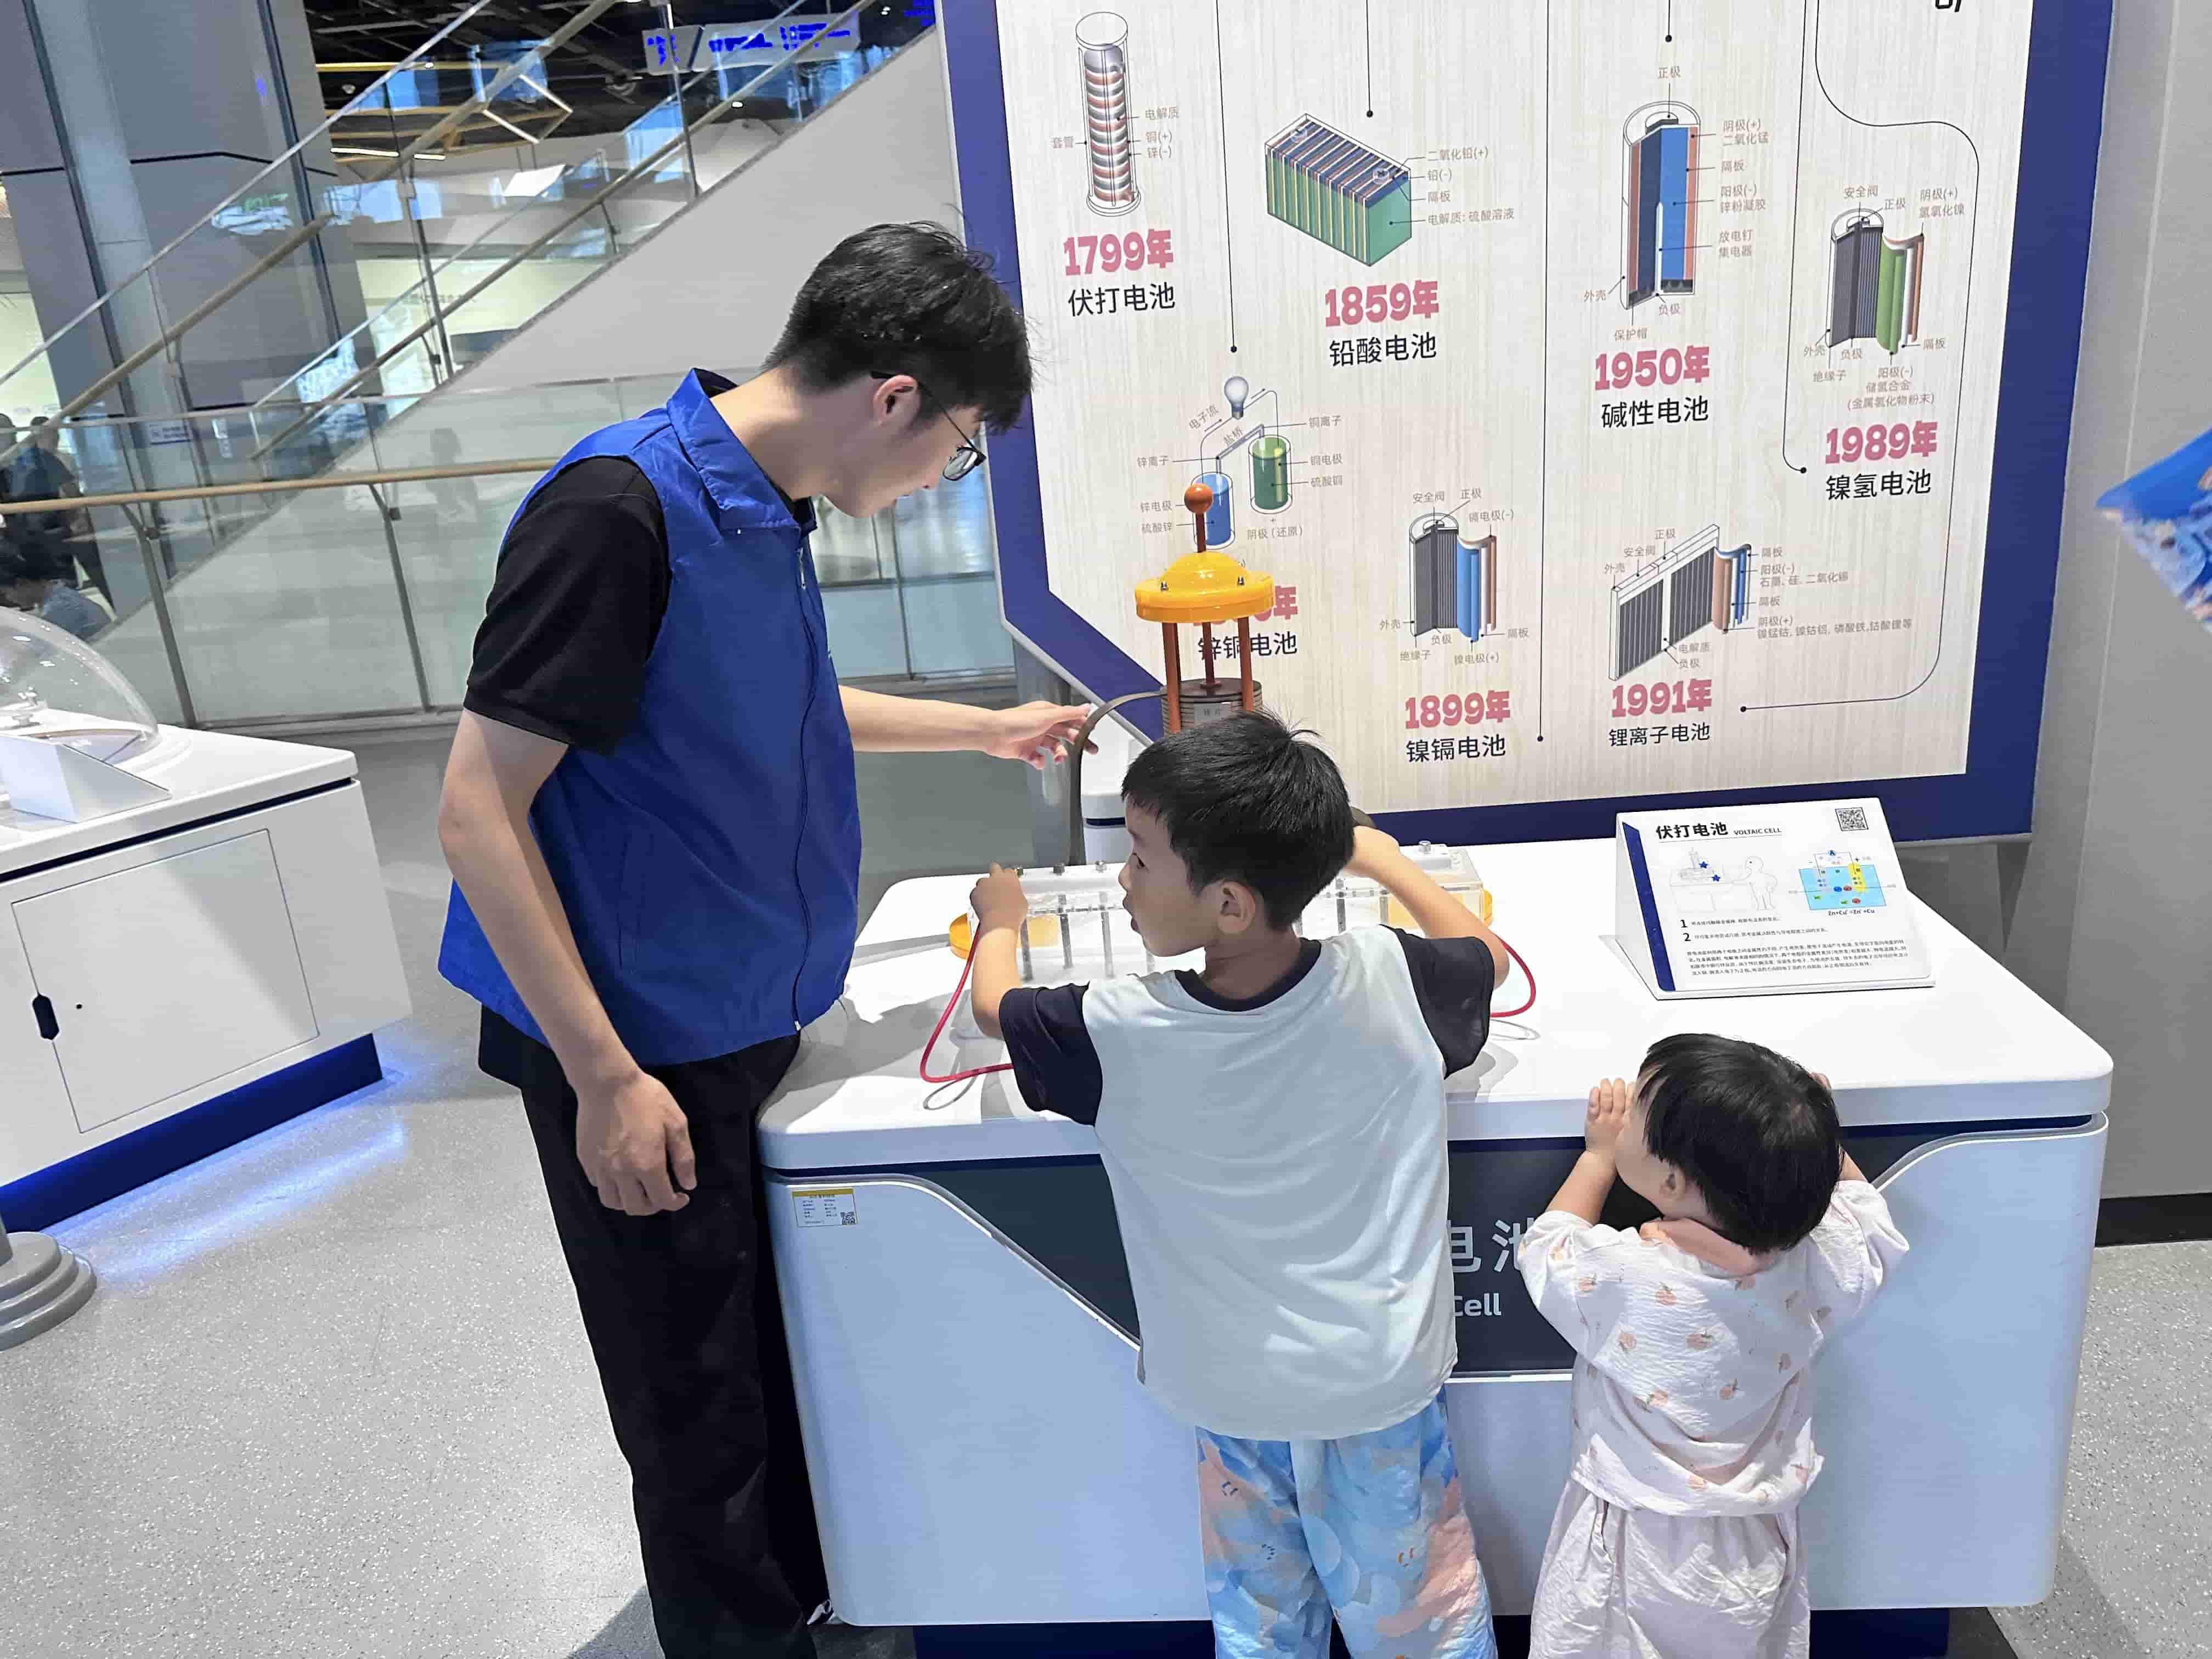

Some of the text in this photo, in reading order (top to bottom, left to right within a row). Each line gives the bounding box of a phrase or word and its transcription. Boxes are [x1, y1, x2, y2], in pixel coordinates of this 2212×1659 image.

[1657, 66, 1681, 79] 正极
[1144, 105, 1181, 121] 电解质
[1723, 119, 1760, 133] 阴极(+)
[1427, 146, 1488, 162] 二氧化铅(+)
[1844, 185, 1878, 199] 安全阀
[1920, 187, 1958, 202] 阴极(+)
[1884, 198, 1906, 211] 正极
[1063, 229, 1173, 275] 1799年
[1068, 281, 1176, 317] 伏打电池
[1325, 279, 1439, 327] 1859年
[1584, 289, 1606, 302] 外壳
[1329, 331, 1437, 367] 铅酸电池
[1595, 346, 1709, 391] 1950年
[1601, 395, 1708, 428] 碱性电池
[1825, 420, 1938, 465] 1989年
[1826, 469, 1931, 500] 镍氢电池
[1413, 491, 1445, 504] 安全阀
[1461, 487, 1482, 500] 正极
[1654, 528, 1675, 540] 正极
[1612, 679, 1712, 718] 1991年
[1405, 690, 1510, 729] 1899年
[1609, 722, 1710, 747] 锂离子电池
[1406, 733, 1506, 763] 镍镉电池
[1656, 822, 1728, 839] 伏打电池
[1680, 919, 1688, 928] 1
[1683, 933, 1691, 941] 2
